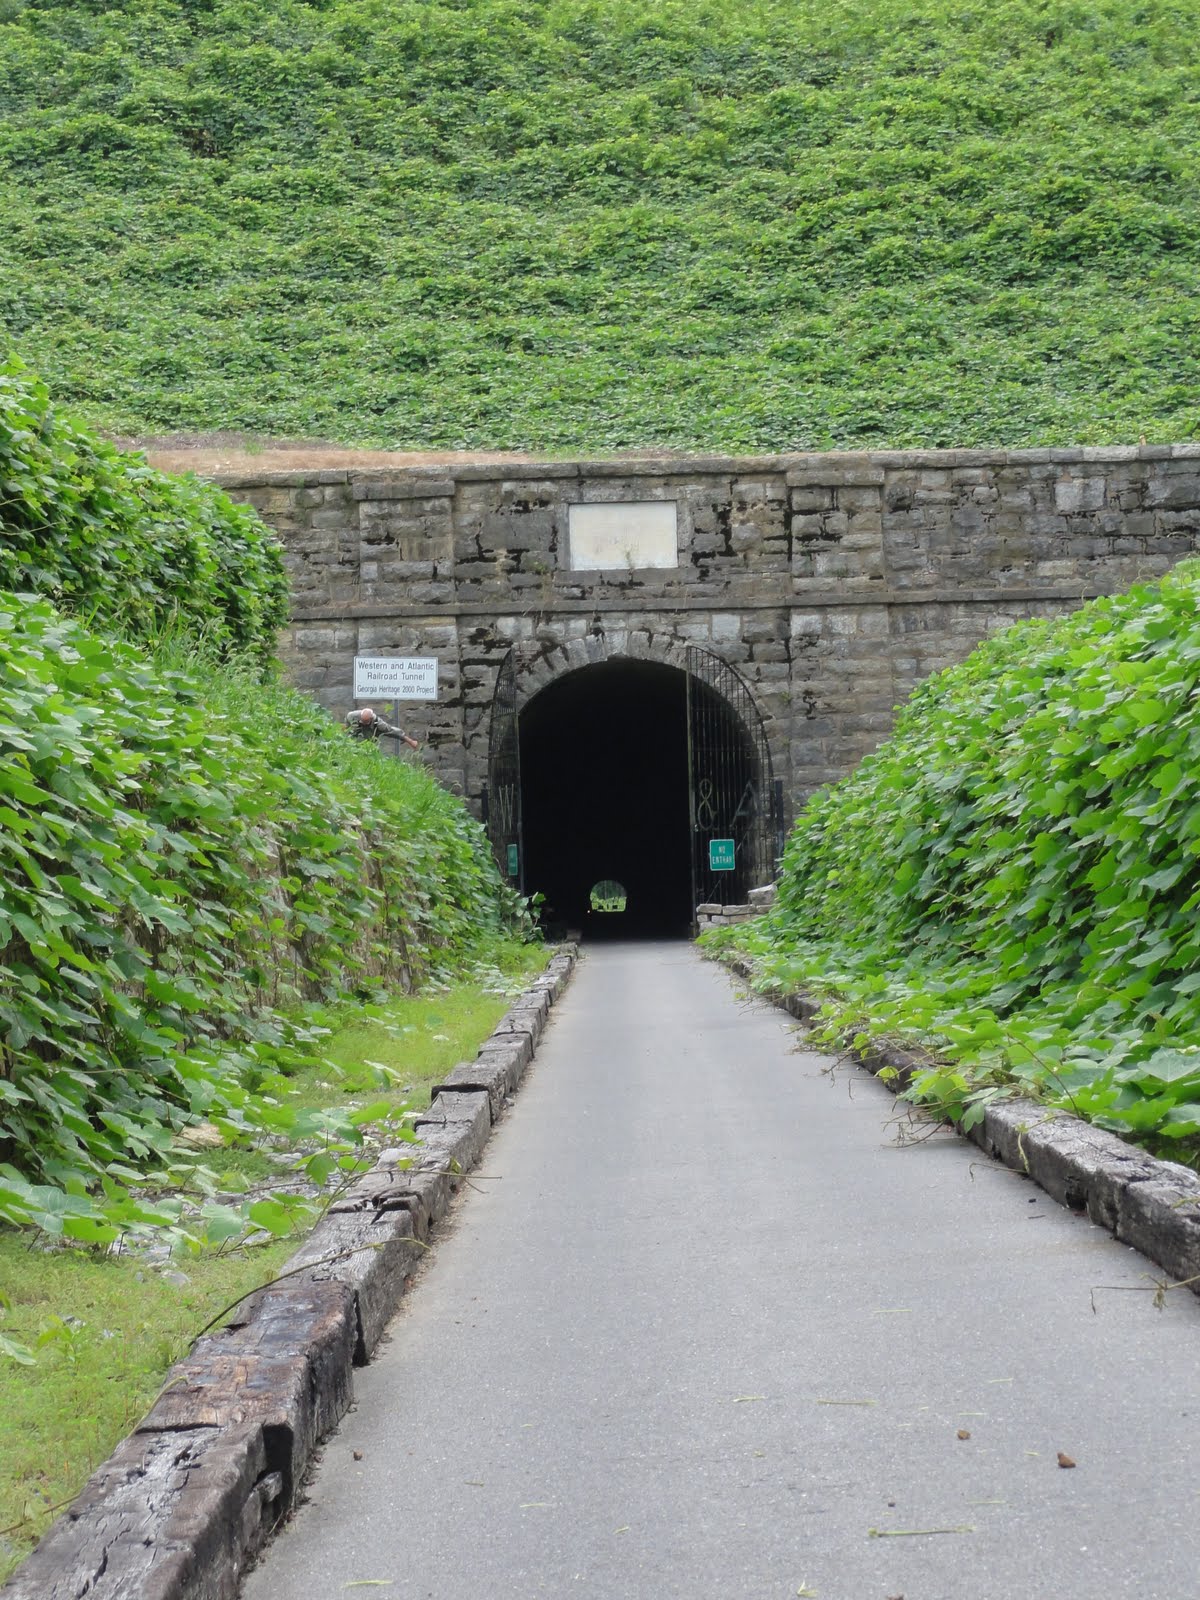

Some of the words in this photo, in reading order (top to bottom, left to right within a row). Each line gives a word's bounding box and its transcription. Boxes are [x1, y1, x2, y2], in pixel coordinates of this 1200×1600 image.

[358, 661, 387, 669] Western
[408, 662, 434, 670] Atlantic
[367, 672, 397, 680] Railroad
[402, 672, 425, 680] Tunnel
[357, 685, 377, 694] Georgia
[379, 685, 400, 695] Heritage
[416, 686, 434, 695] Project
